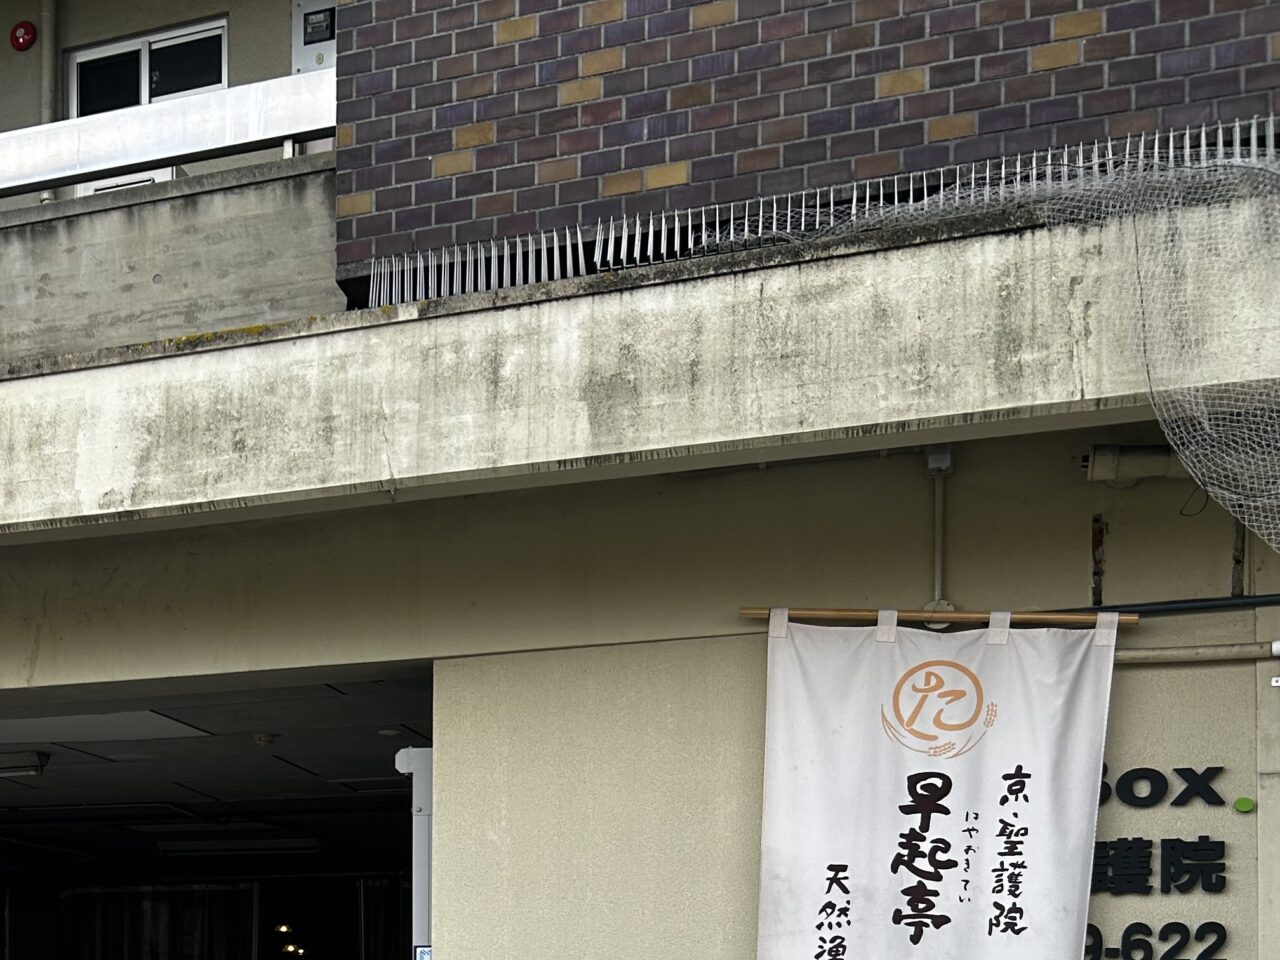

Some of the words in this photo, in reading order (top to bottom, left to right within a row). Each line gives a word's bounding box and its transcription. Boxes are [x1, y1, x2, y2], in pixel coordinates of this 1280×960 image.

[959, 810, 980, 903] はやおきてい
